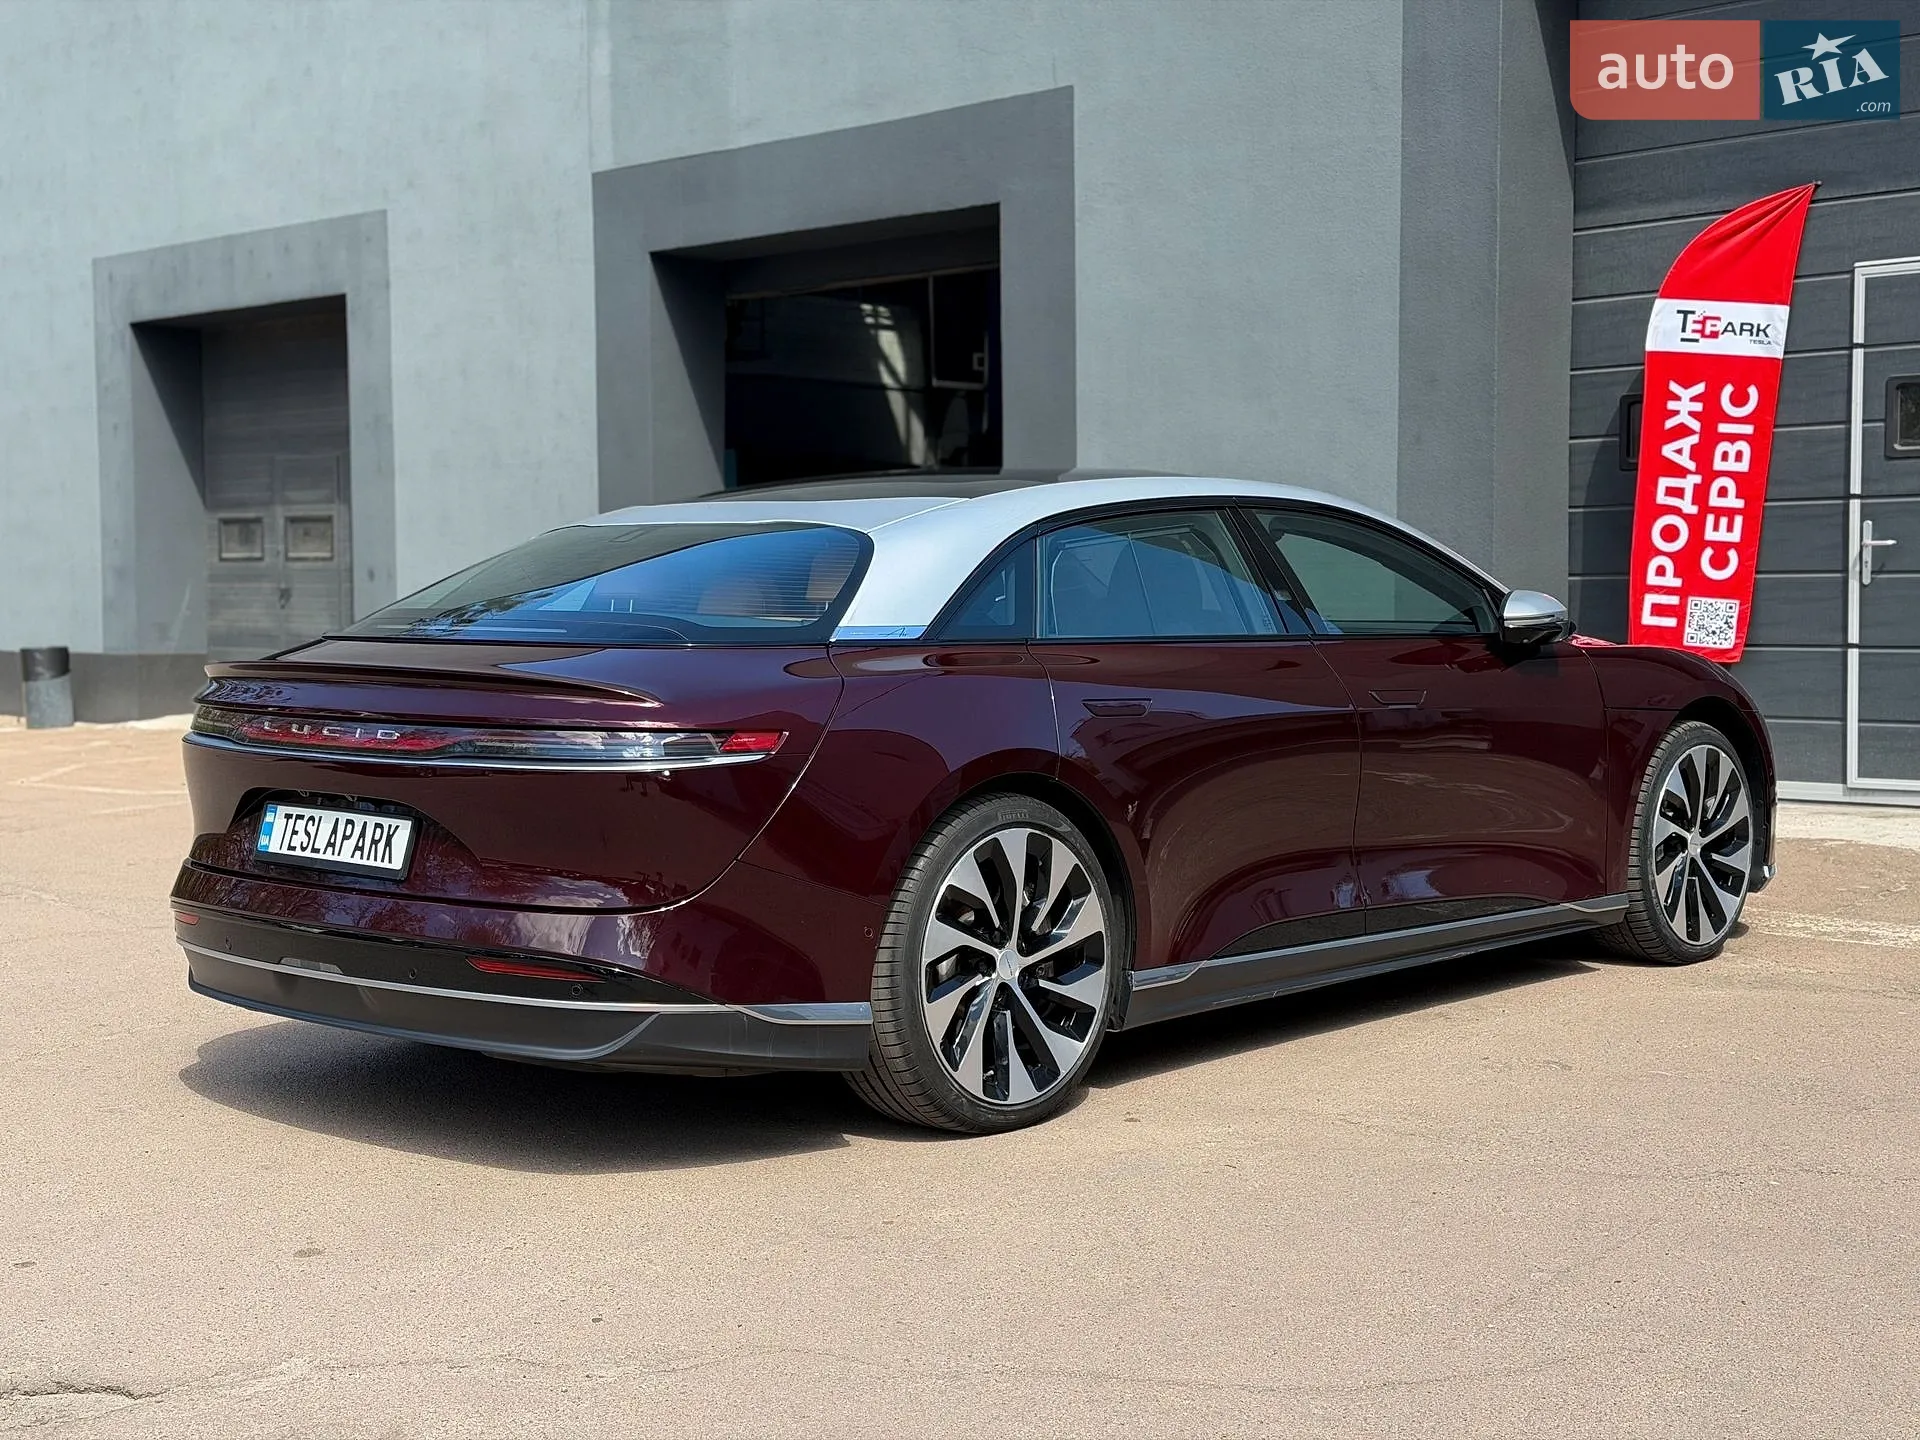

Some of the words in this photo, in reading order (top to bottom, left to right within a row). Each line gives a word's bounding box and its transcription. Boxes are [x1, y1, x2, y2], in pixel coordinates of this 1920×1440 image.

[1641, 380, 1706, 627] ПРОДАЖ
[1700, 383, 1759, 581] СЕРВІС
[263, 721, 400, 740] LUCID
[279, 812, 400, 864] TESLAPARK
